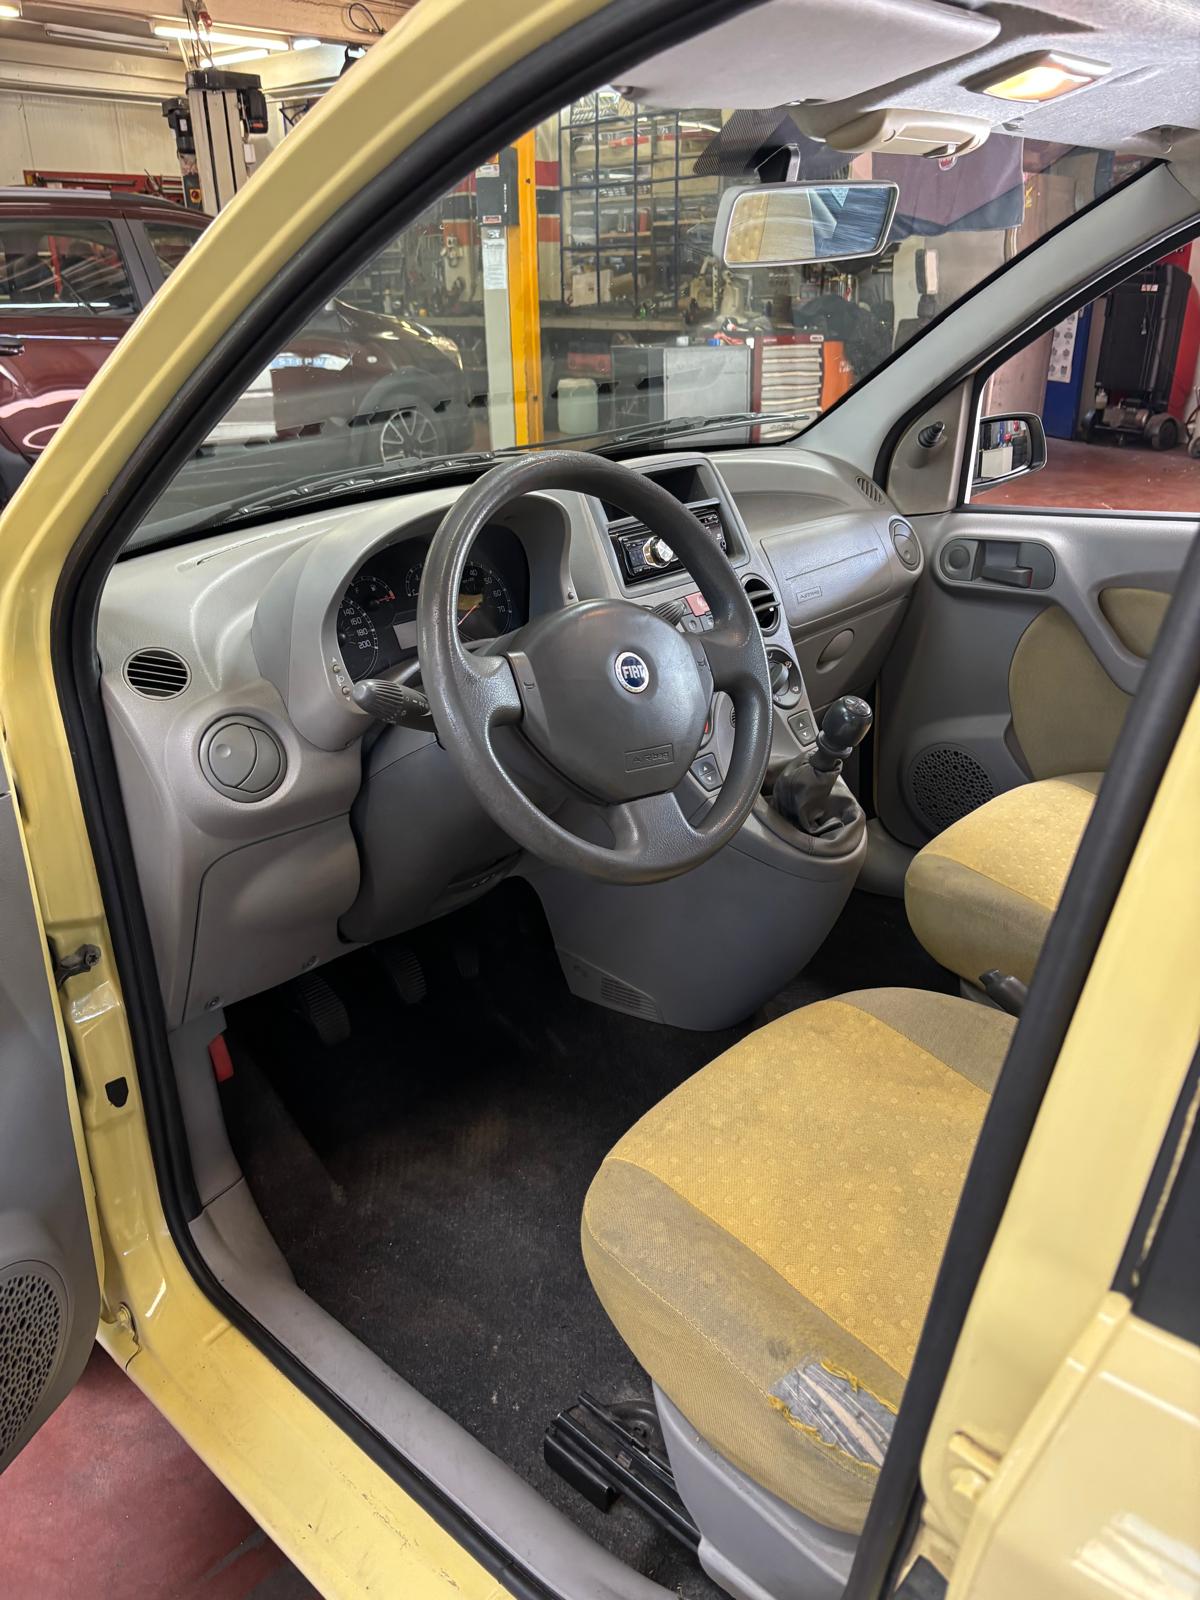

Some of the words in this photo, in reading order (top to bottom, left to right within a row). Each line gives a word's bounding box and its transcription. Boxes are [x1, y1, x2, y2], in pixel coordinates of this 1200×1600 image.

[350, 617, 362, 626] 160
[356, 627, 369, 636] 180
[358, 639, 372, 650] 200
[621, 664, 645, 679] FIAT
